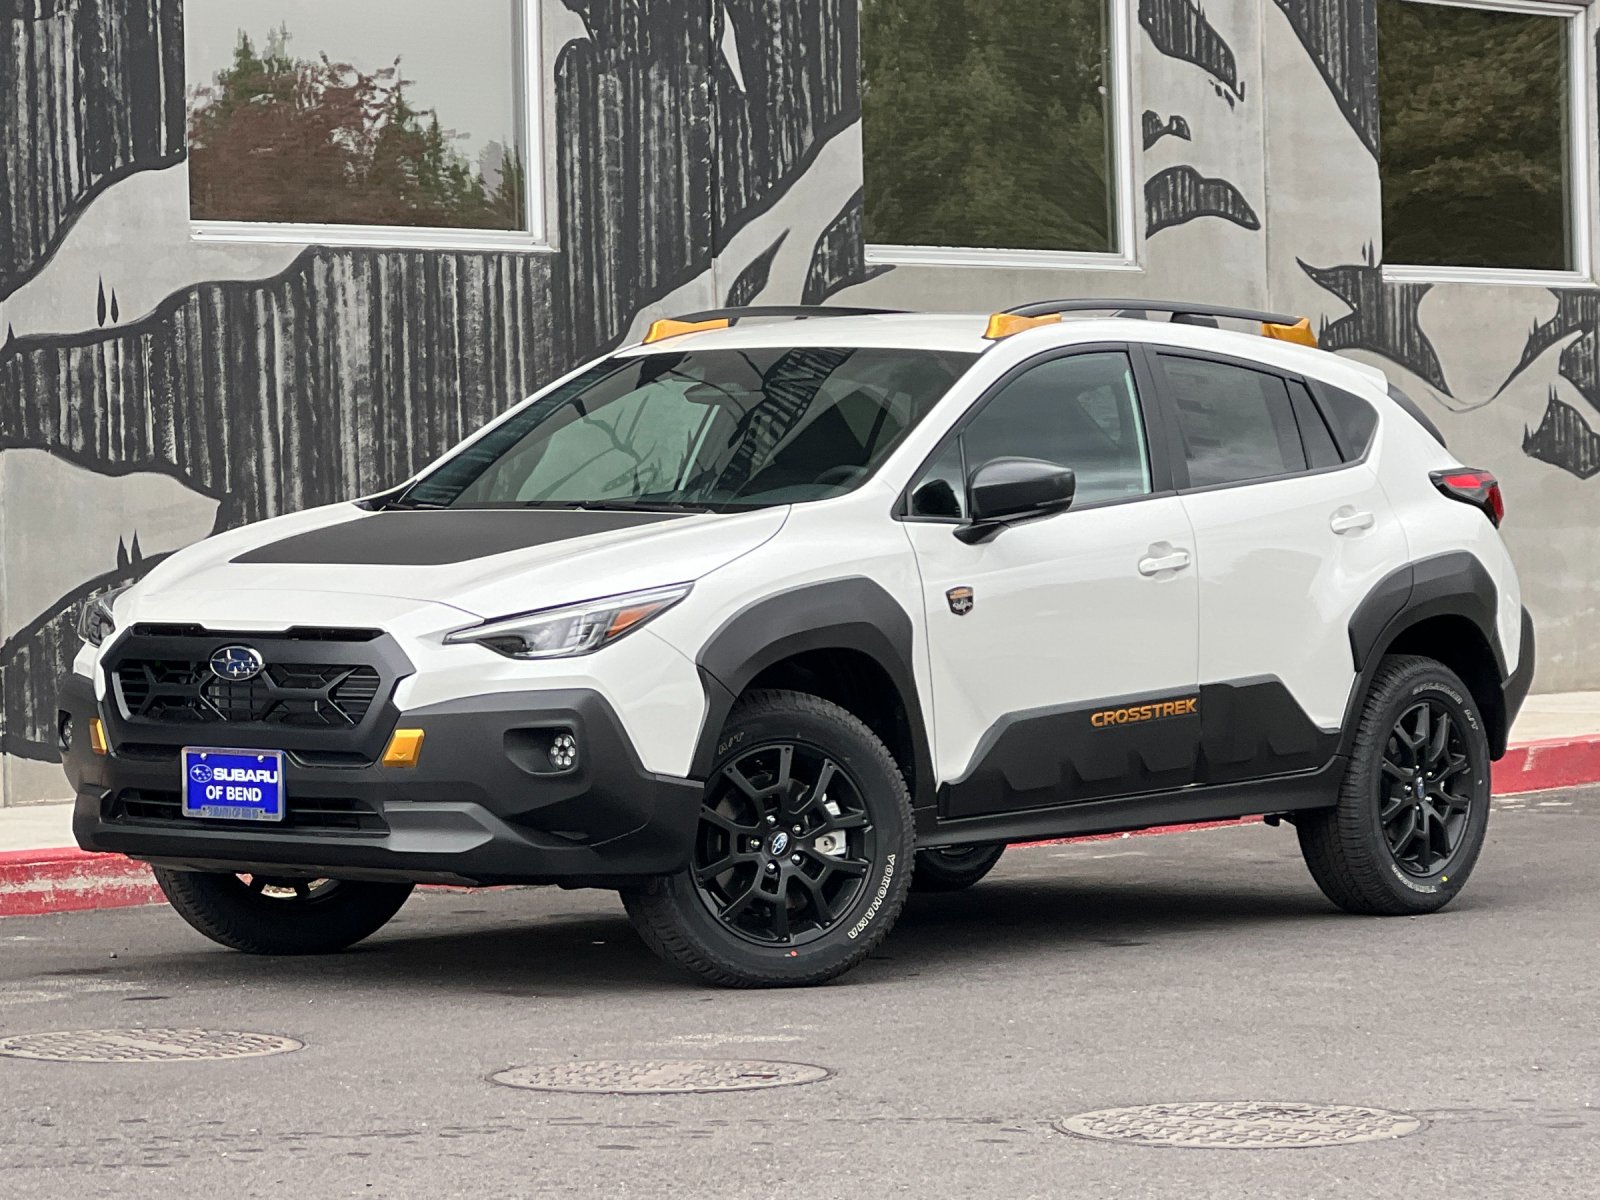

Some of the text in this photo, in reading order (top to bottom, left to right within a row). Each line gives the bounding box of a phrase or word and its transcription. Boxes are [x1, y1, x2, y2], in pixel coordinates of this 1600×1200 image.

[1091, 698, 1197, 727] CROSSTREK
[213, 767, 278, 783] SUBARU
[205, 785, 262, 802] OF BEND
[847, 854, 896, 939] YOKOHAMA
